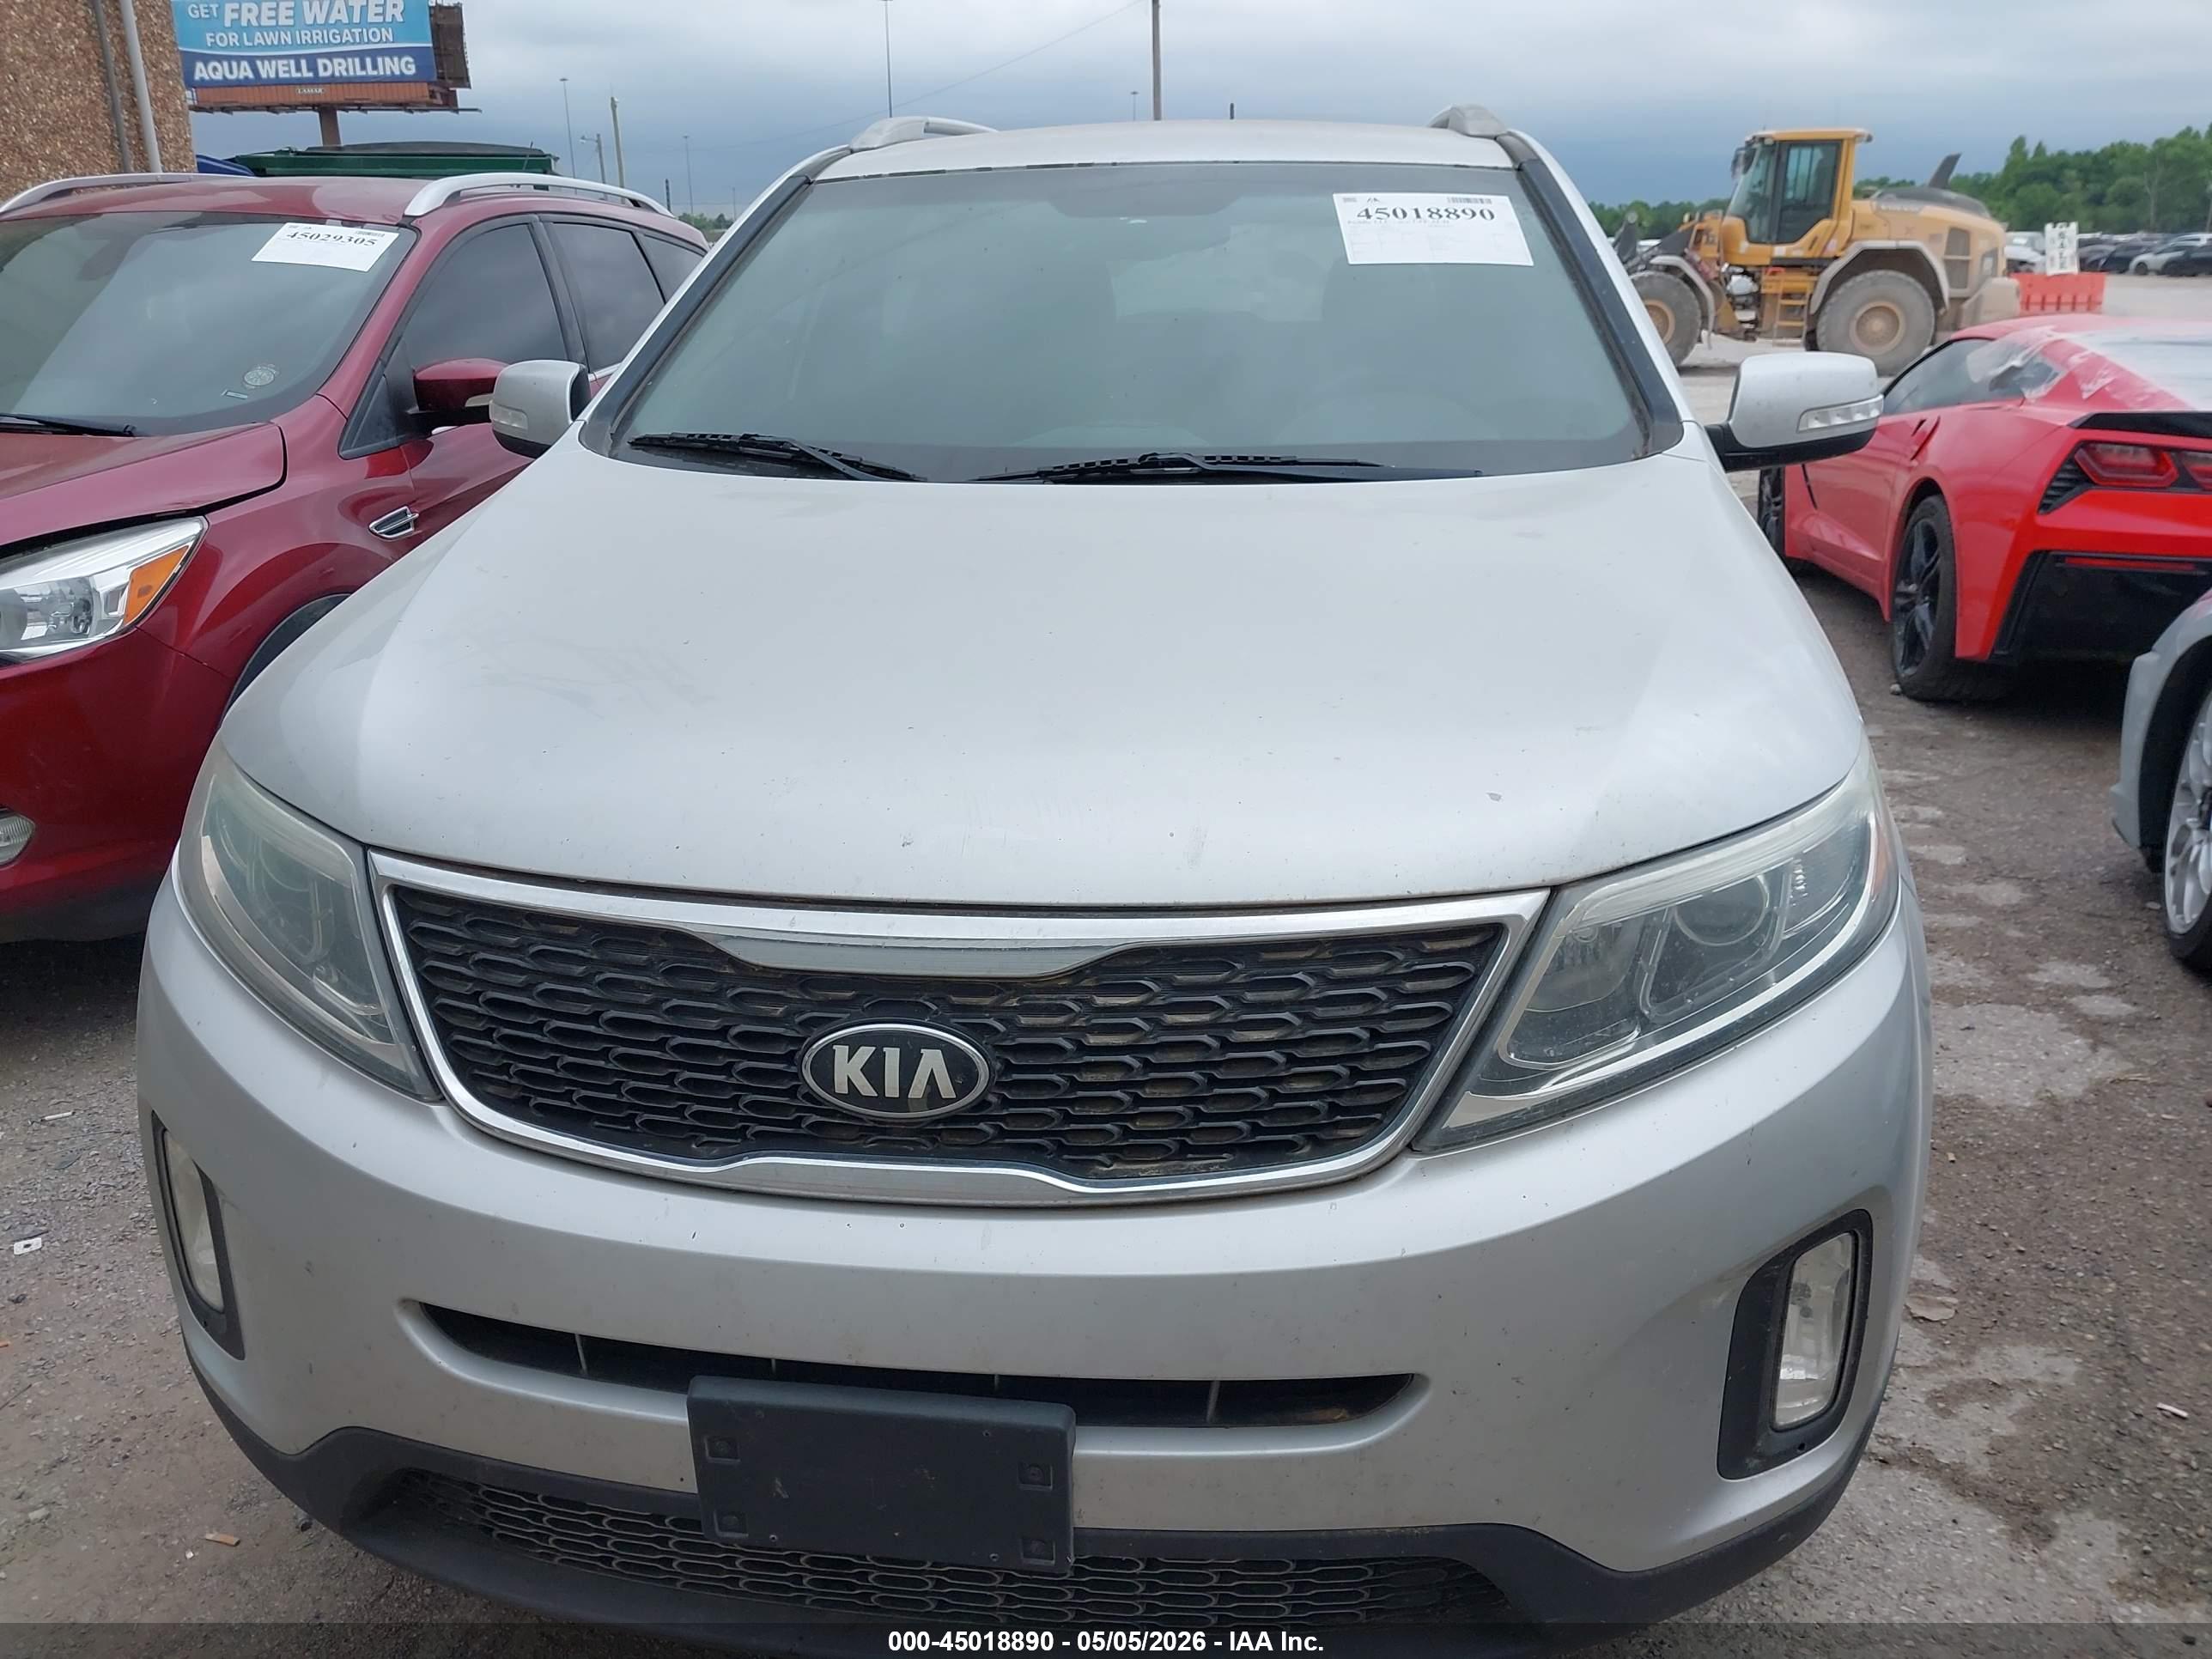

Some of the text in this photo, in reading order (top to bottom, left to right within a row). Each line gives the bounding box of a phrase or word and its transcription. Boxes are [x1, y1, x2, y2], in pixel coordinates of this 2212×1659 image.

[187, 0, 405, 27] GET FREE WATER
[205, 27, 393, 48] FOR LAWN IRRIGATION
[193, 55, 416, 81] AQUA WELL DRILLING
[1356, 206, 1496, 222] 45018890
[286, 231, 379, 246] 45029305
[832, 1044, 957, 1099] KIA
